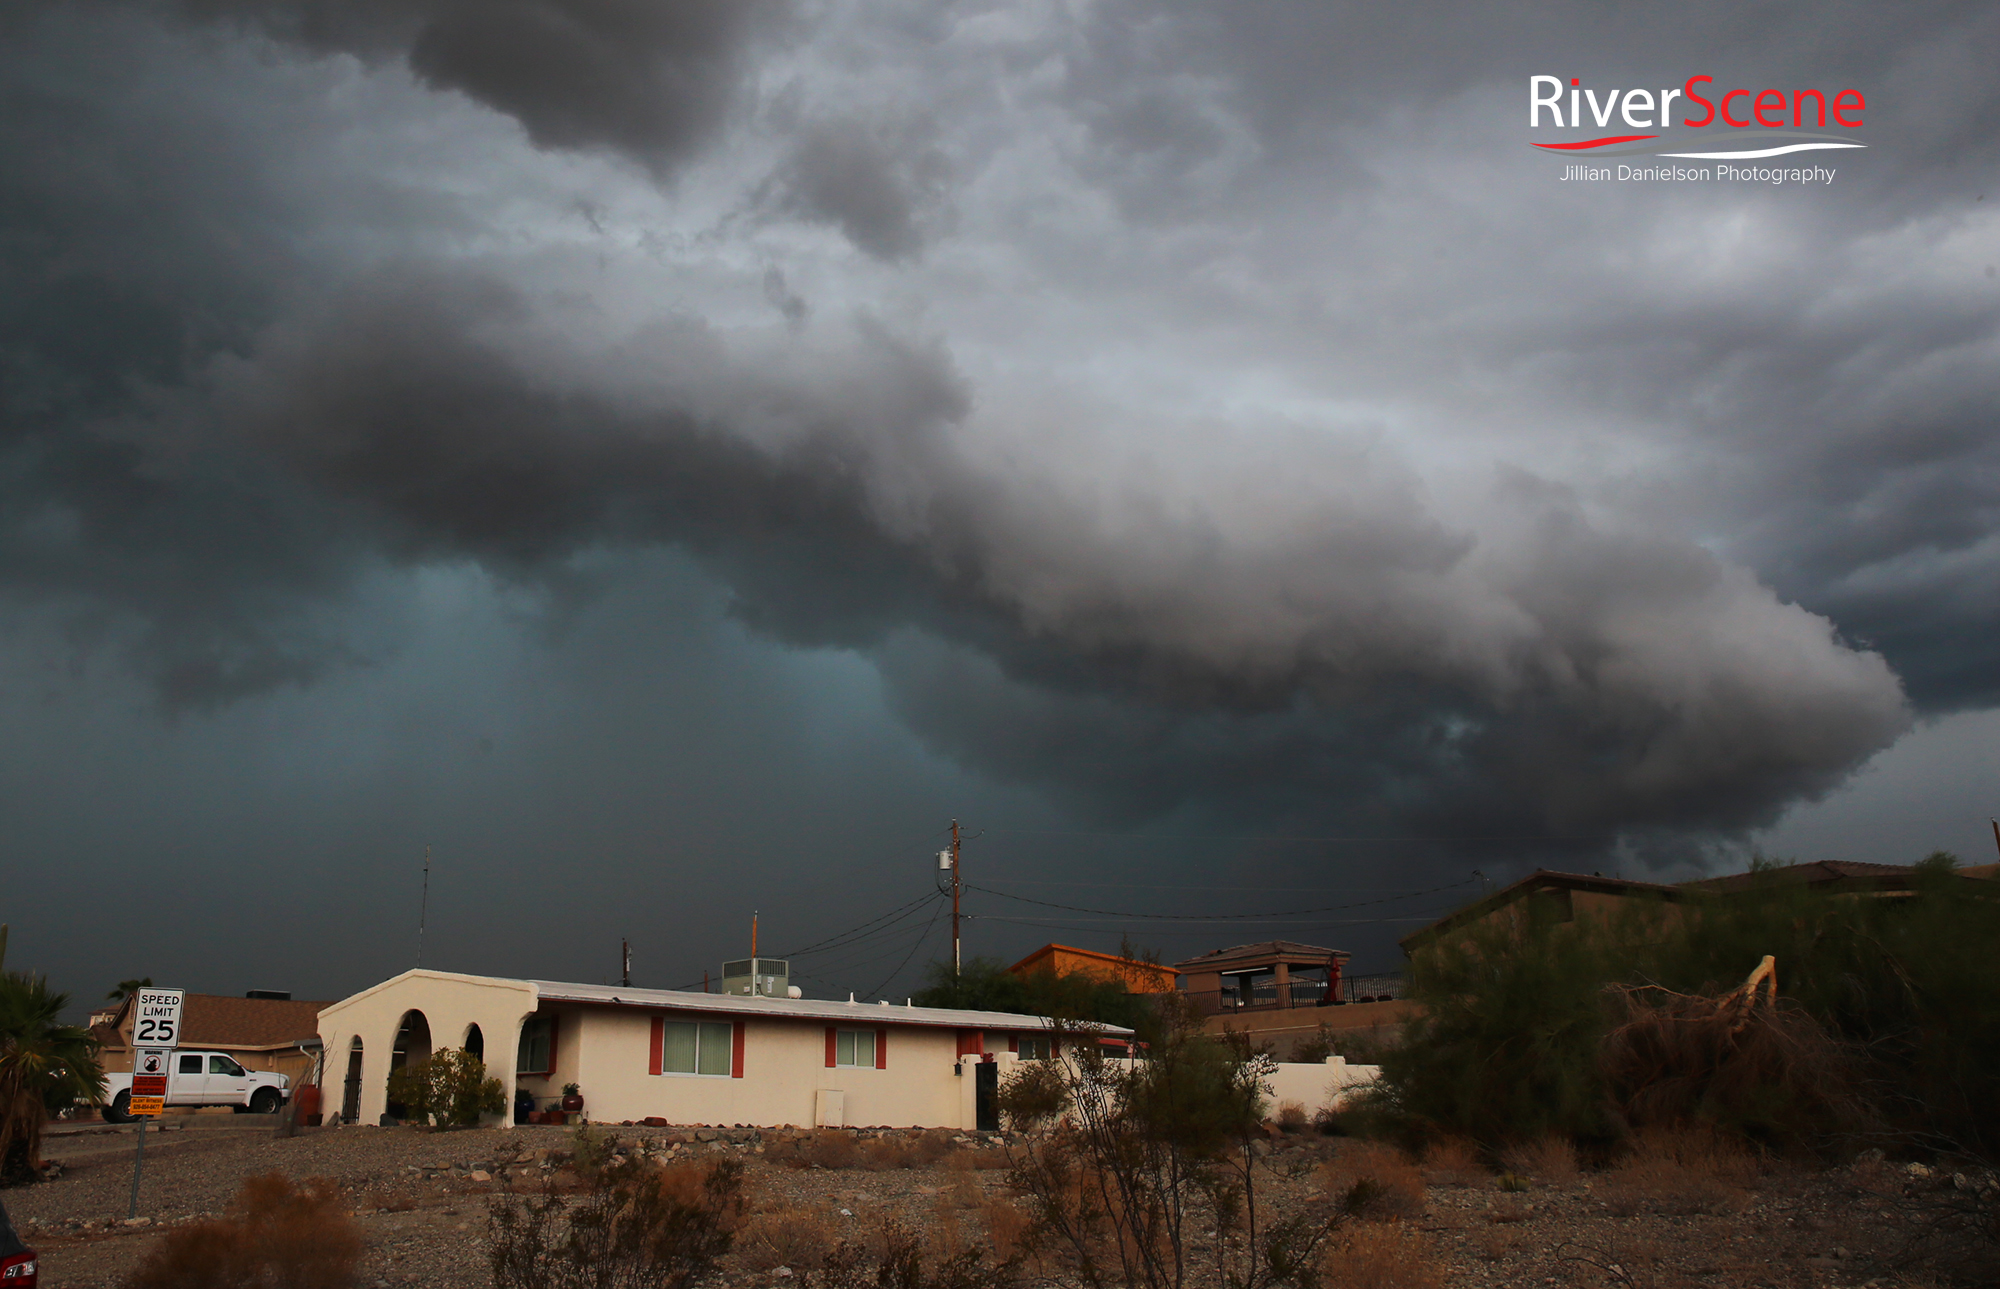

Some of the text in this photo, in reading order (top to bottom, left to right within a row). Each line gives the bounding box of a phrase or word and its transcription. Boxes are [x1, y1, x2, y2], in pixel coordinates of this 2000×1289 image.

[141, 995, 179, 1005] SPEED
[143, 1007, 174, 1016] LIMIT
[138, 1019, 174, 1041] 25
